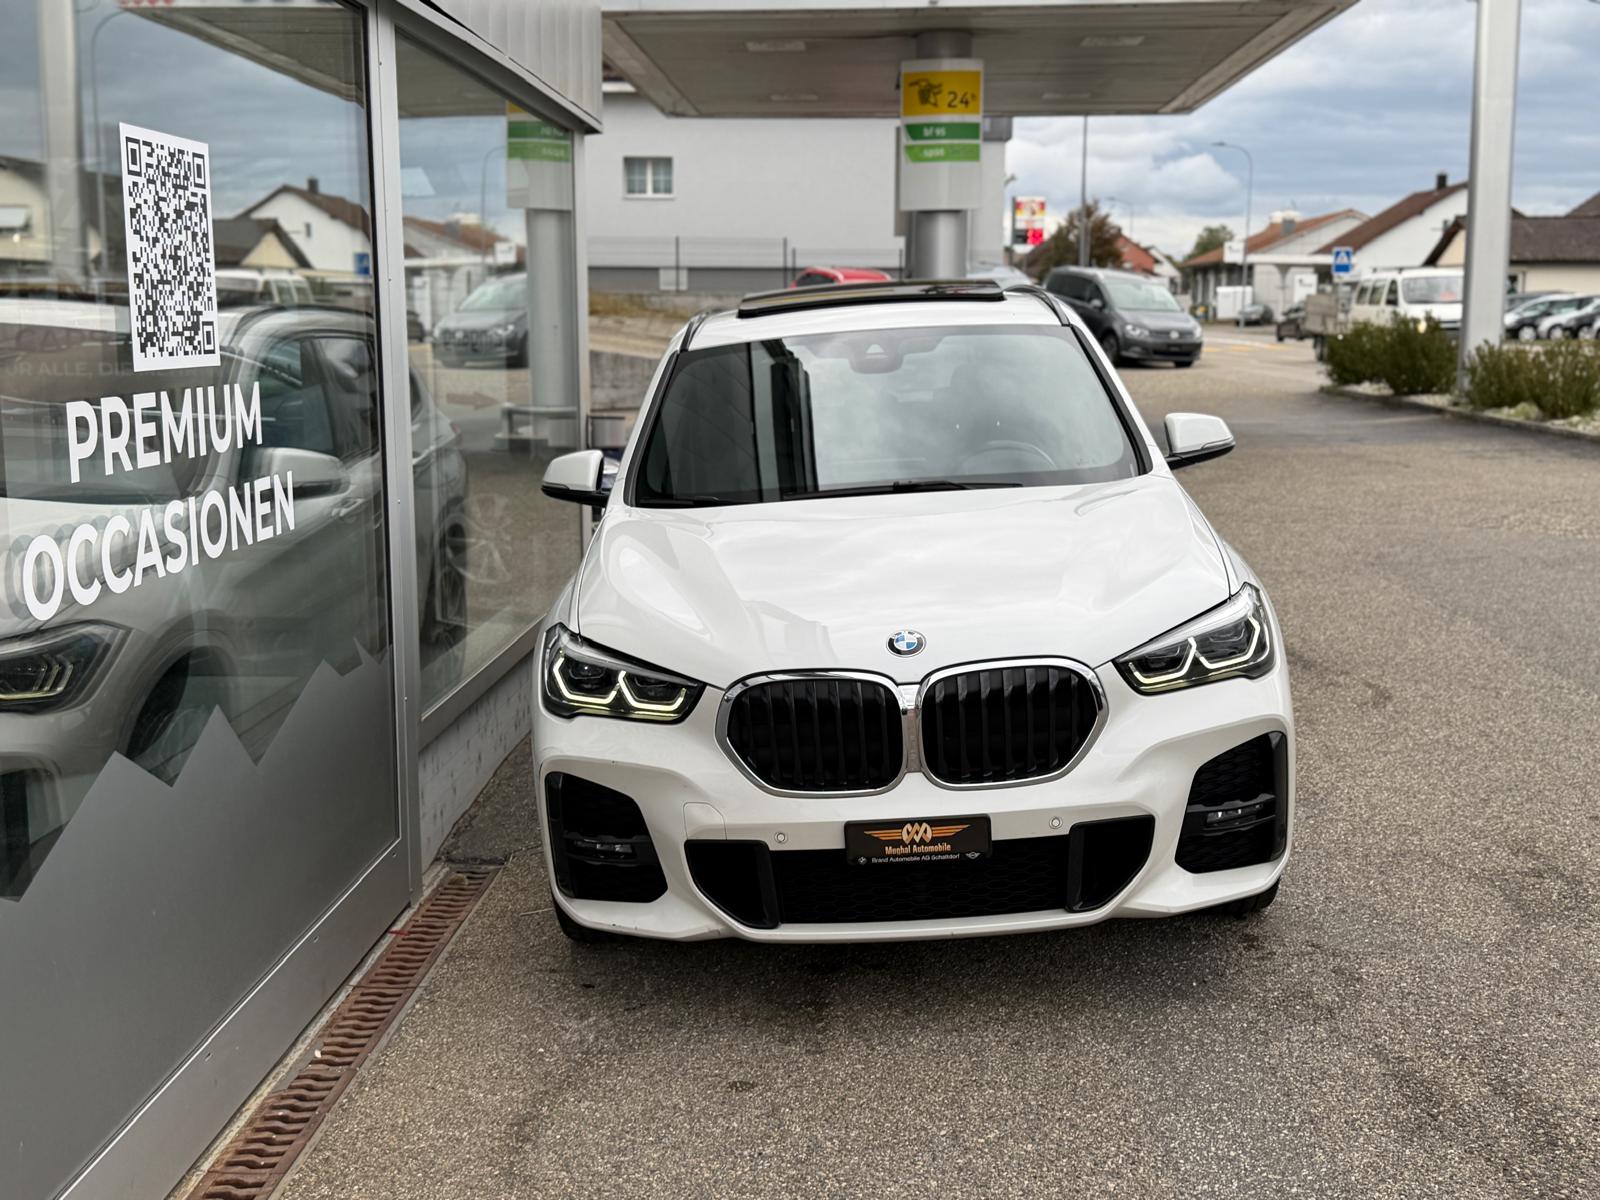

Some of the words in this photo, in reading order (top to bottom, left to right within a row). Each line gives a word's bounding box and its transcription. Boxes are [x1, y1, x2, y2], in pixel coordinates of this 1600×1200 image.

[66, 381, 263, 484] PREMIUM
[22, 470, 296, 622] OCCASIONEN
[913, 842, 951, 853] Automobile
